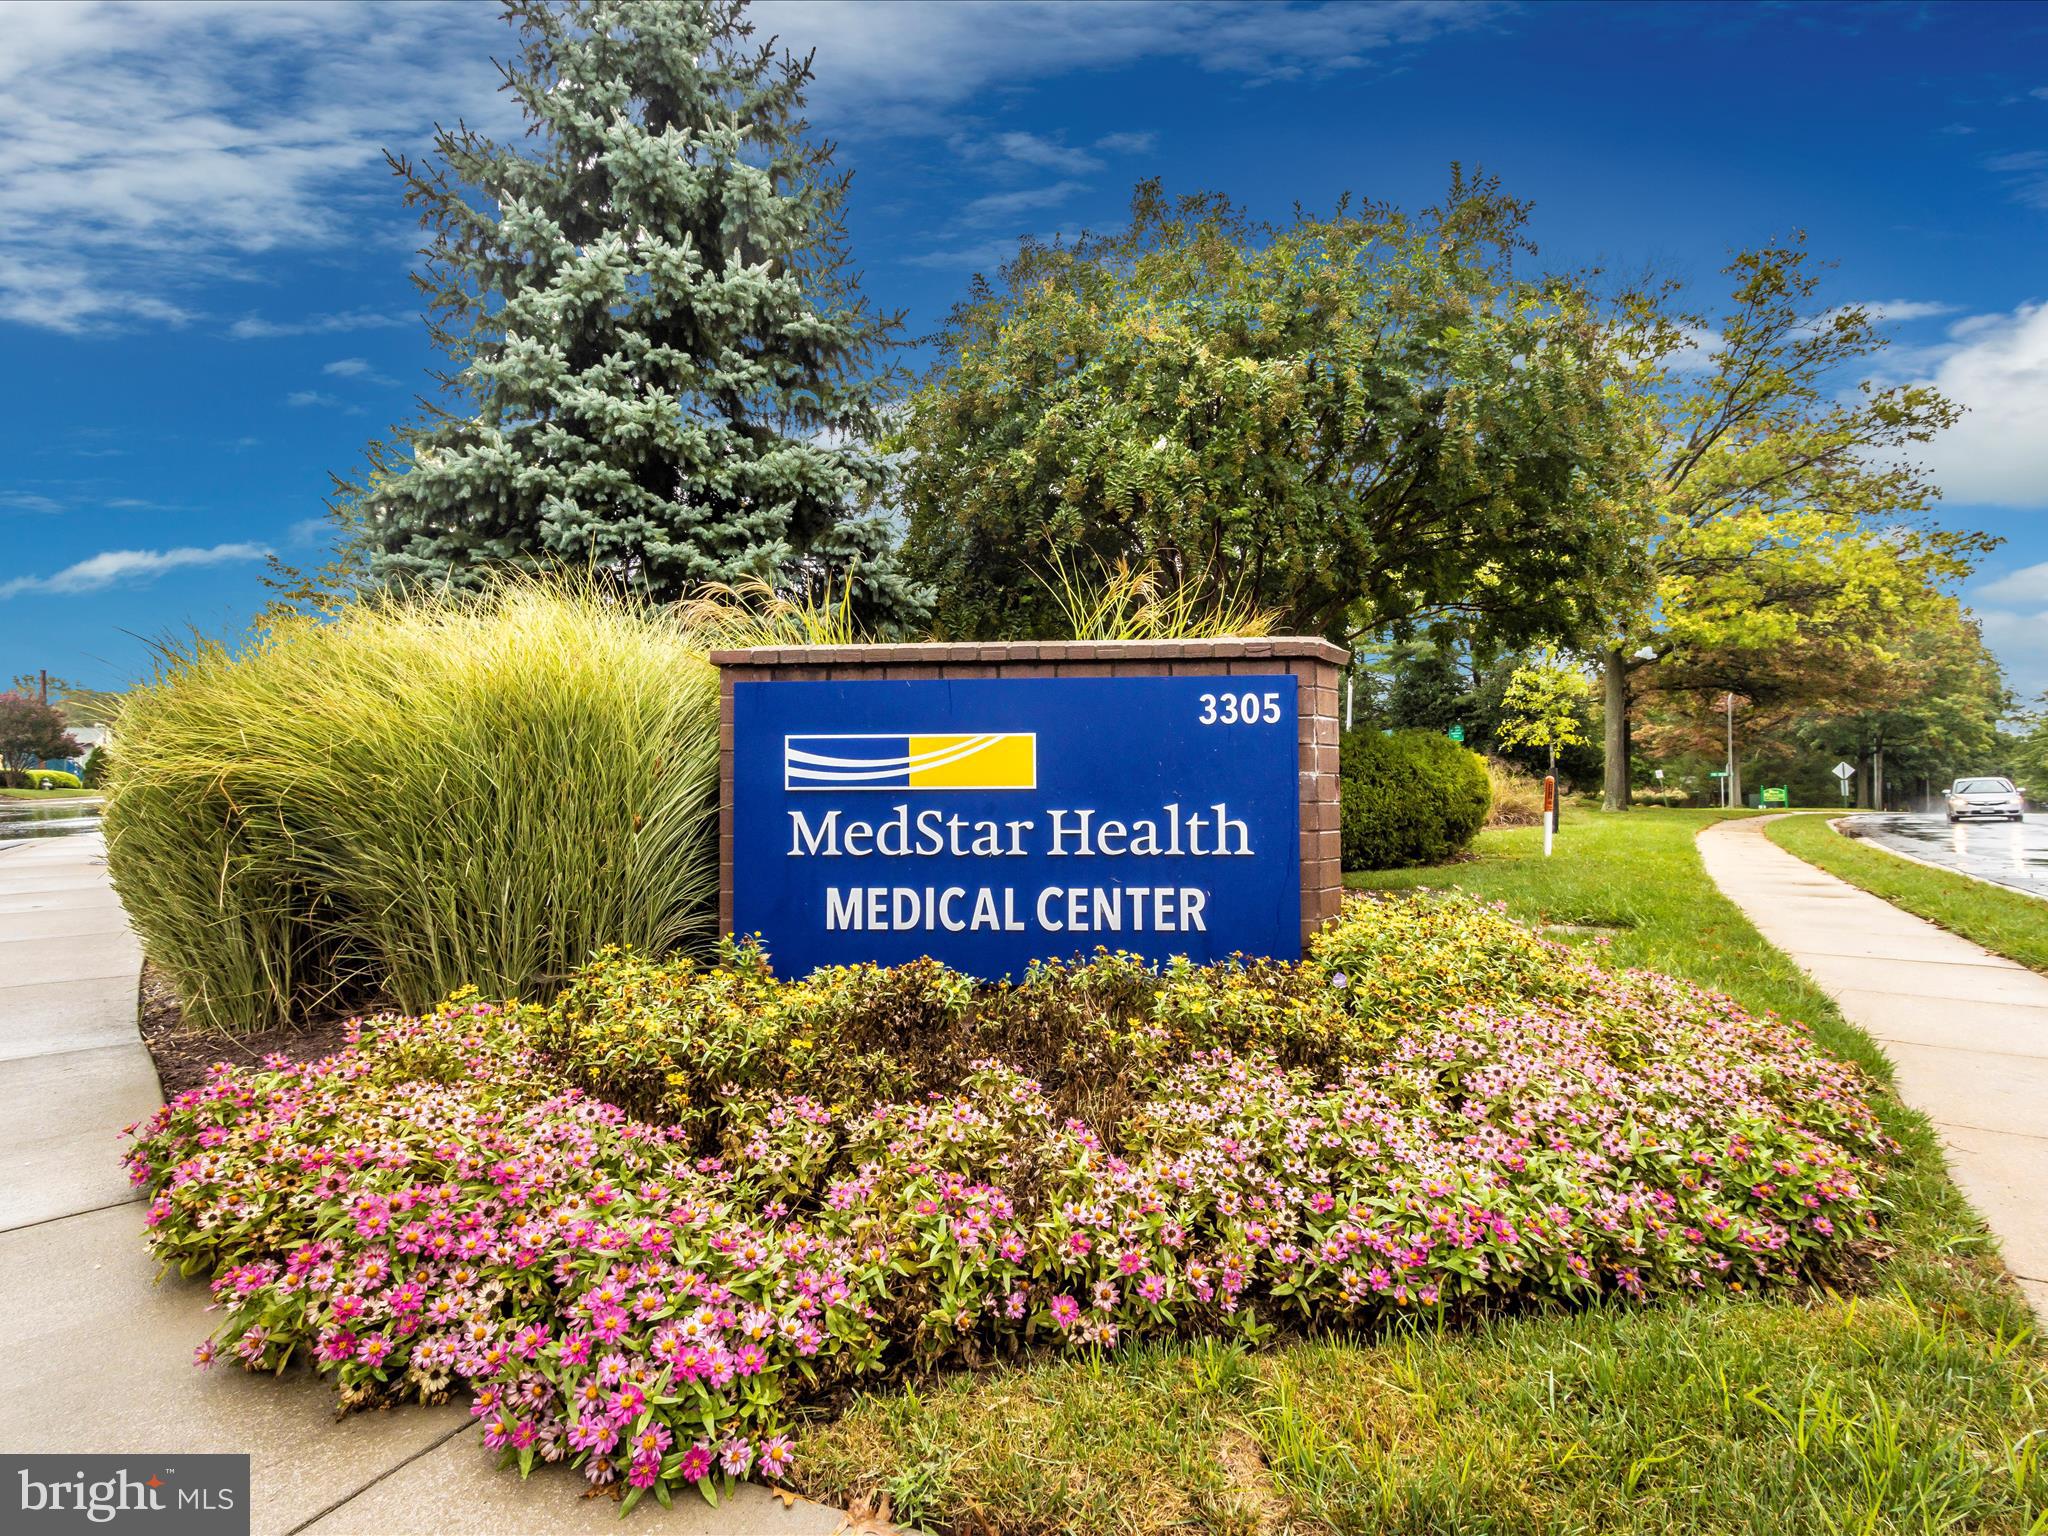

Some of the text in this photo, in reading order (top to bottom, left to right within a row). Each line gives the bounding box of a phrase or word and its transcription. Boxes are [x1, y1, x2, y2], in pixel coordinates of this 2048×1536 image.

[1198, 692, 1281, 725] 3305
[786, 802, 1255, 857] MedStar Health
[825, 886, 1208, 932] MEDICAL CENTER
